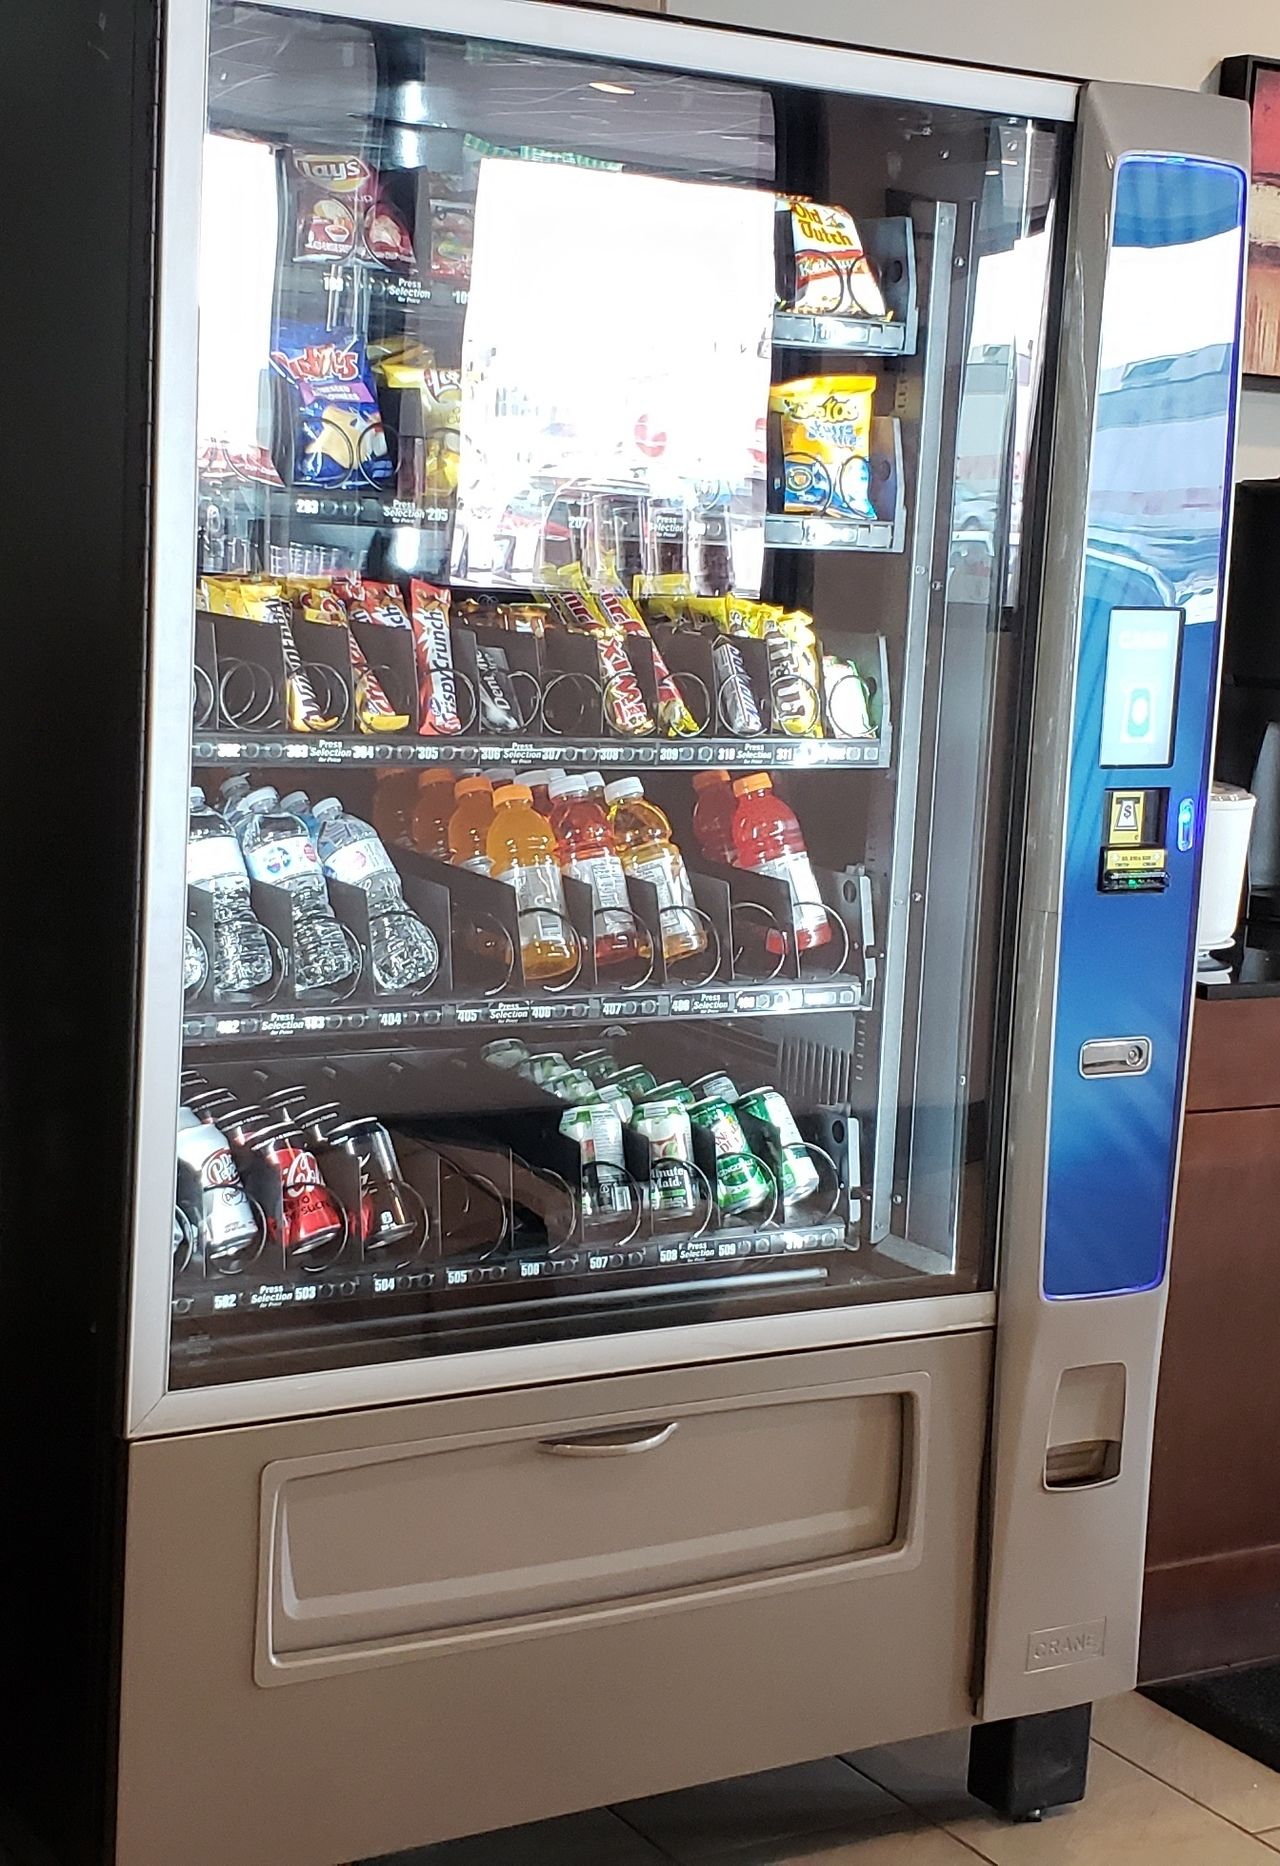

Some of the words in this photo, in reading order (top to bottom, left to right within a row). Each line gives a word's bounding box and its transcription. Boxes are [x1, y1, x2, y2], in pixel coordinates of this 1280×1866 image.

[793, 203, 823, 226] Old
[798, 218, 853, 246] Dutch
[398, 277, 422, 289] Press
[388, 284, 431, 299] Selection
[393, 498, 416, 508] Press
[382, 505, 426, 519] Selection
[427, 508, 449, 522] 205
[656, 515, 677, 524] Press
[319, 739, 343, 749] Press
[744, 743, 765, 751] Press
[309, 746, 353, 757] Selection
[418, 747, 438, 759] 305
[481, 748, 501, 760] 306
[503, 749, 542, 759] Selection
[543, 748, 562, 760] 307
[600, 748, 618, 760] 308
[736, 749, 772, 759] Selection
[701, 993, 721, 1001] Press
[498, 1002, 519, 1010] Press
[603, 1003, 621, 1015] 407
[693, 1000, 729, 1010] Selection
[271, 1012, 295, 1022] Press
[381, 1012, 402, 1026] 404
[457, 1011, 477, 1022] 405
[489, 1009, 528, 1019] Selection
[261, 1020, 305, 1030] Selection
[687, 1242, 707, 1250] Press
[679, 1249, 715, 1259] Selection
[590, 1256, 608, 1269] 507
[448, 1270, 467, 1284] 505
[260, 1285, 283, 1294] Press
[375, 1278, 395, 1292] 504
[295, 1285, 316, 1300] 503
[251, 1293, 293, 1304] Selection
[1033, 1633, 1098, 1660] CRANE
